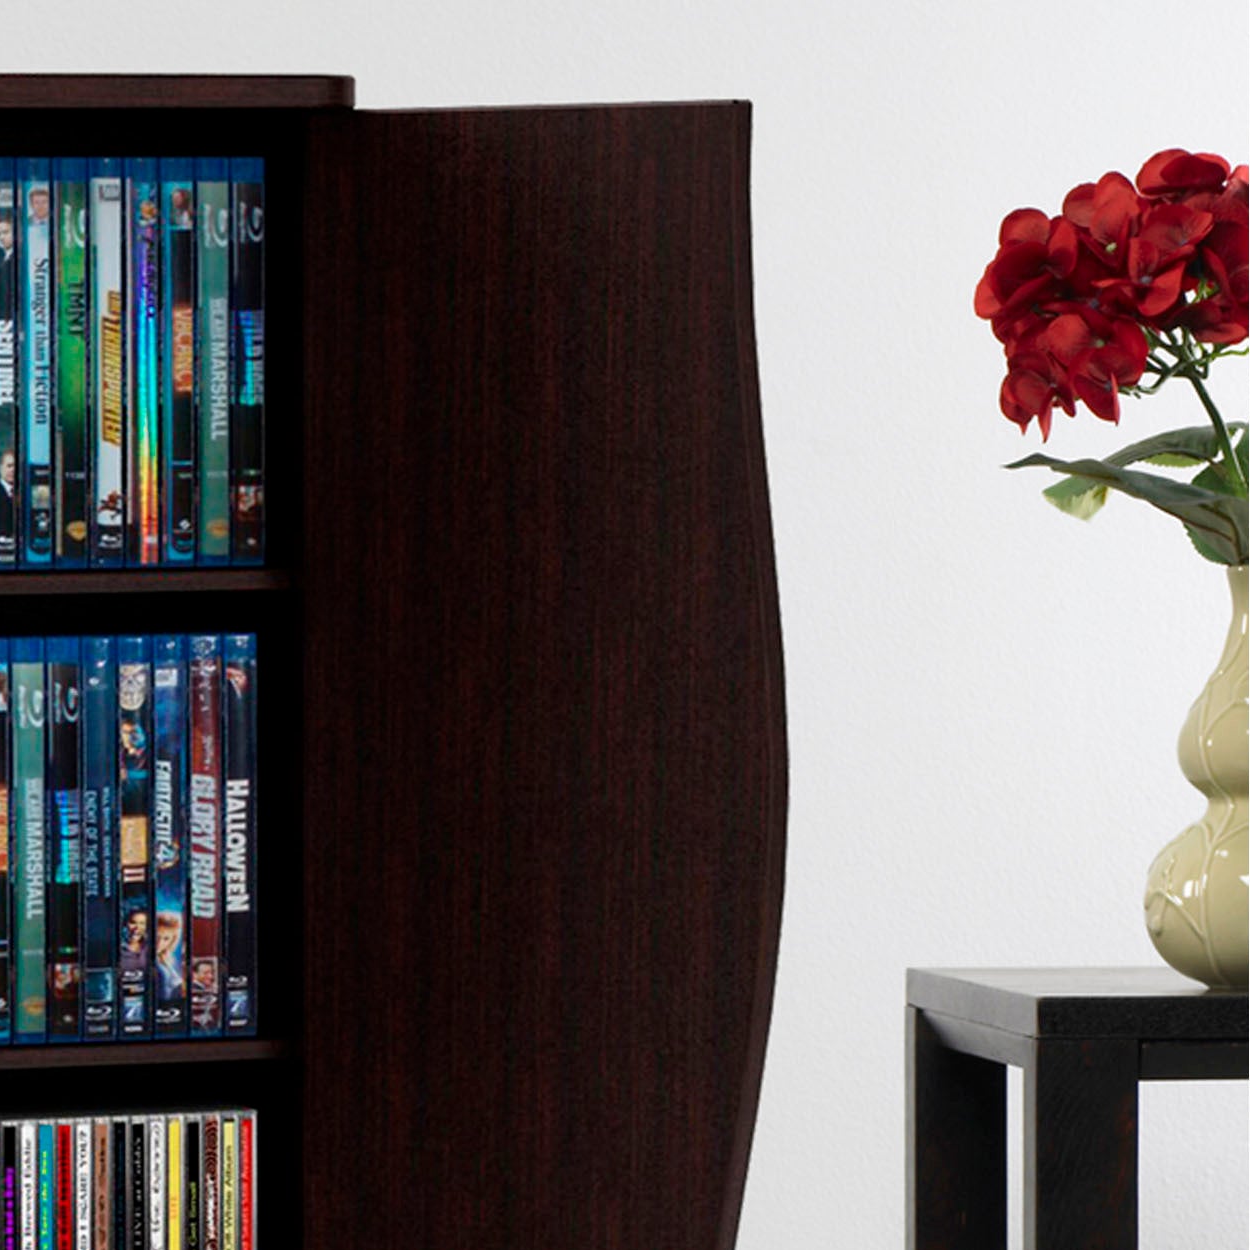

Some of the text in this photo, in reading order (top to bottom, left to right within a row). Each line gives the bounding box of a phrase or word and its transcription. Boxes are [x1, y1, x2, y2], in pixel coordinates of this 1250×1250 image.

[33, 258, 50, 425] Stranger than Fiction
[65, 280, 84, 336] TMNT
[101, 316, 121, 446] TRANSPORTER
[211, 342, 228, 441] MARSHALL
[86, 828, 98, 839] OF
[155, 761, 174, 846] FANTASTIC
[191, 774, 216, 852] GLORY
[26, 822, 43, 920] MARSHALL
[86, 844, 98, 862] THE
[191, 853, 216, 918] ROAD
[226, 779, 250, 912] HALLOWEEN
[225, 1145, 234, 1188] Album
